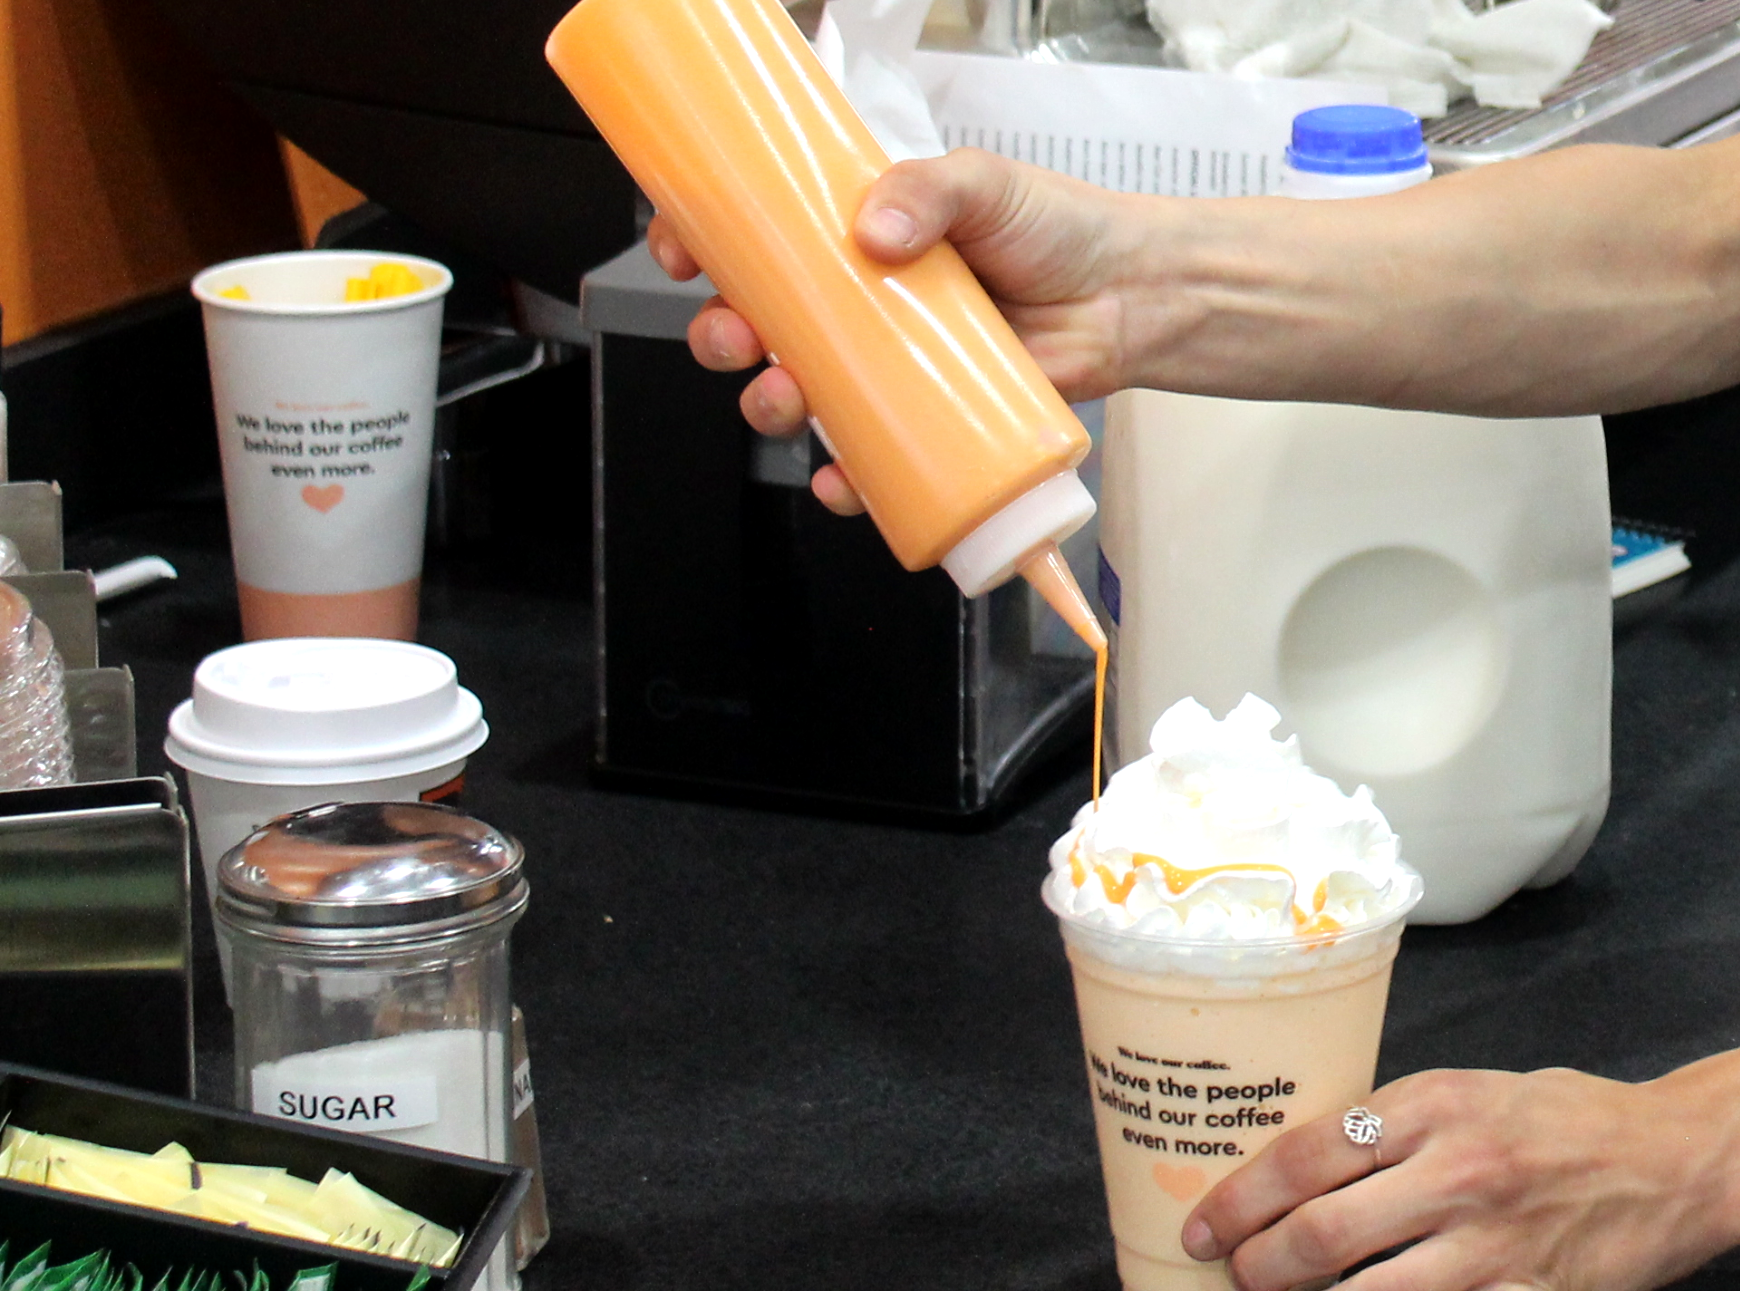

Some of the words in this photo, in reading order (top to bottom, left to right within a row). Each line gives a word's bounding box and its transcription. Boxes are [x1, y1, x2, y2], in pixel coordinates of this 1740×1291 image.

[236, 413, 260, 430] We
[264, 416, 304, 435] love
[310, 418, 344, 435] the
[350, 410, 410, 436] people
[243, 435, 303, 456] behind
[309, 443, 342, 456] our
[349, 435, 403, 454] coffee
[271, 463, 315, 478] even
[321, 462, 375, 477] more.
[1118, 1046, 1133, 1059] We
[1135, 1051, 1157, 1064] love
[1161, 1059, 1184, 1068] our
[1186, 1060, 1231, 1071] coffee.
[1111, 1062, 1150, 1092] love
[1157, 1077, 1197, 1098] the
[1207, 1076, 1296, 1104] people
[279, 1090, 396, 1121] SUGAR
[1096, 1080, 1151, 1120] behind
[1158, 1109, 1197, 1126] our
[1205, 1107, 1285, 1127] coffee
[1122, 1127, 1167, 1151] even
[1175, 1139, 1244, 1156] more.
